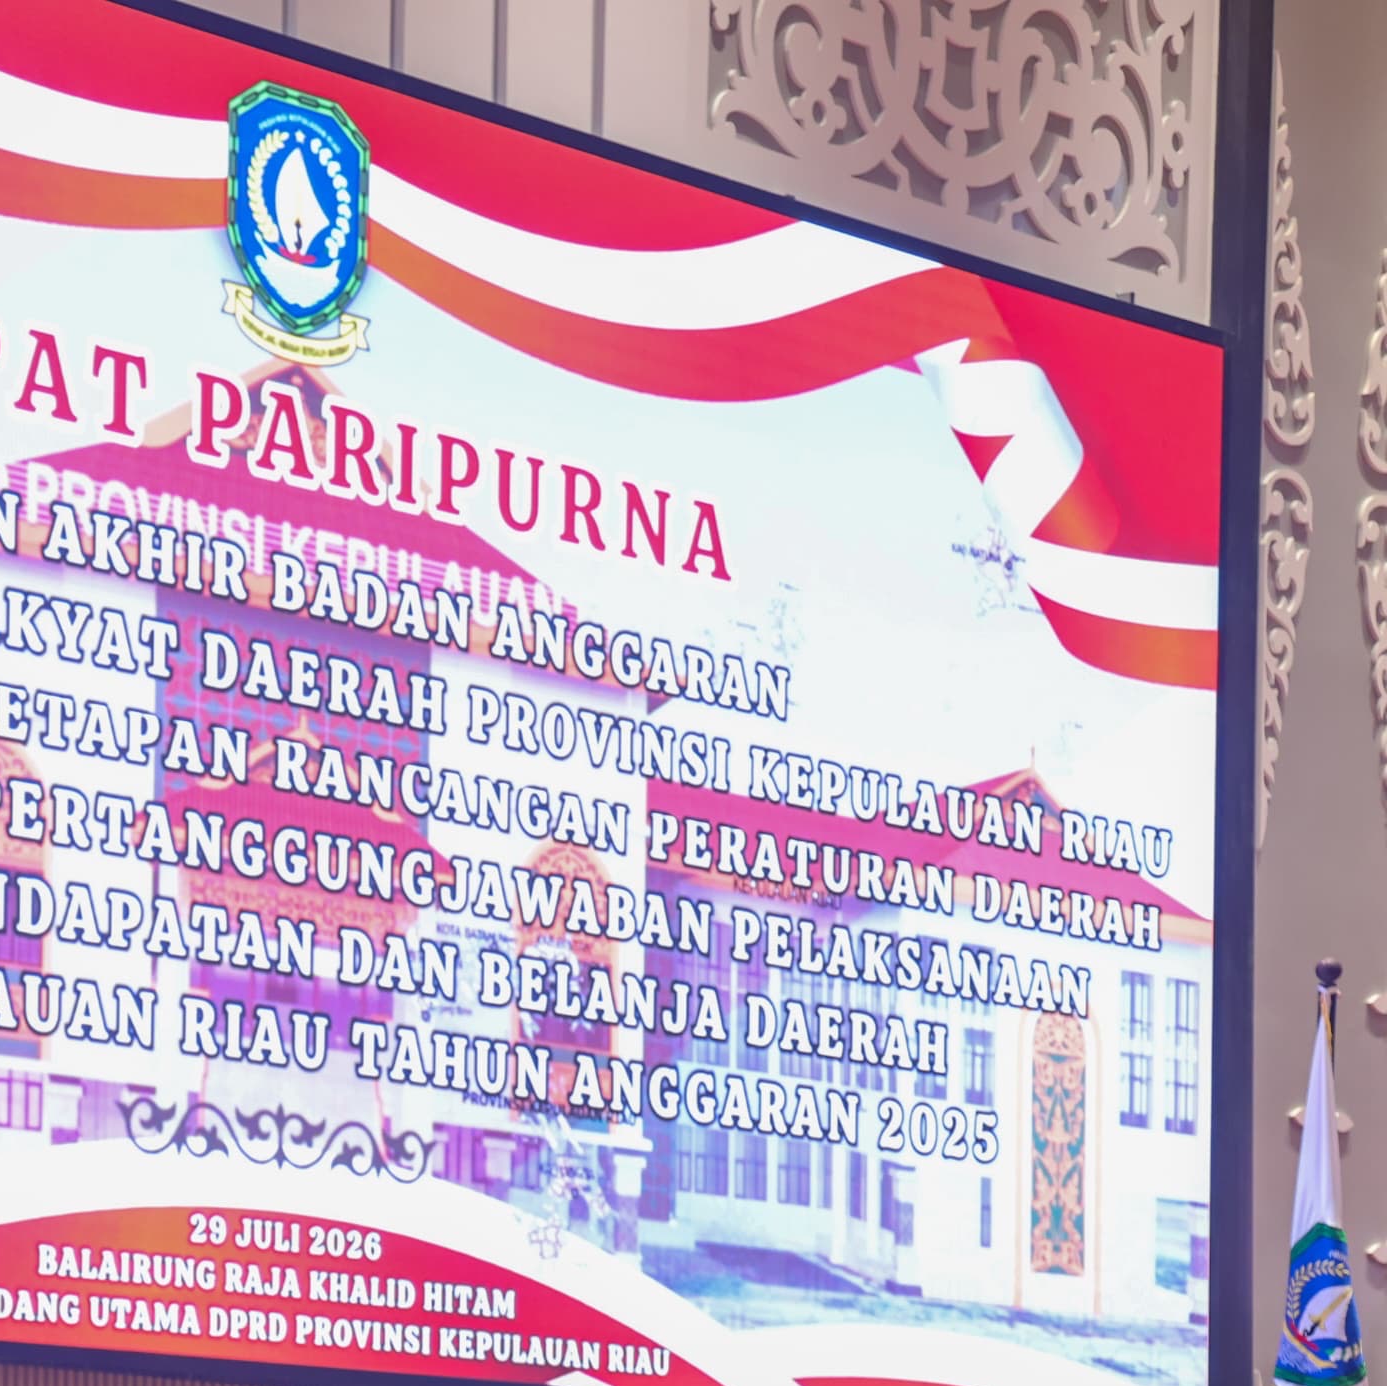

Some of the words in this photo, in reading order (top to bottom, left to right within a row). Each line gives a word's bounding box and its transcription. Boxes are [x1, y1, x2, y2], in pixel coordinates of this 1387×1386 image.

[195, 371, 732, 580] PARIPURNA
[44, 503, 247, 602] AKHIR
[271, 550, 470, 648] BADAN
[491, 595, 791, 723] ANGGARAN
[202, 630, 444, 736] DAERAH
[466, 686, 730, 797] PROVINSI
[747, 747, 1042, 855] KEPULAUAN
[1060, 812, 1174, 880] RIAU
[273, 735, 630, 857] RANCANGAN
[648, 812, 953, 916] PERATURAN
[971, 875, 1163, 953] DAERAH
[338, 928, 458, 998] DAN
[479, 947, 728, 1040] BELANJA
[746, 1000, 949, 1077] DAERAH
[732, 901, 1091, 1019] PELAKSANAAN
[180, 997, 329, 1070] RIAU
[350, 1020, 550, 1110] TAHUN
[571, 1056, 859, 1145] ANGGARAN
[878, 1098, 999, 1166] 2025
[37, 1243, 217, 1291] BALAIRUNG
[225, 1260, 301, 1300] RAJA
[310, 1270, 416, 1311] KHALID
[424, 1283, 516, 1320] HITAM
[189, 1213, 230, 1244] 29
[235, 1217, 303, 1252] JULI
[308, 1225, 382, 1261] 2026
[89, 1298, 201, 1336] UTAMA
[209, 1309, 288, 1344] DPRD
[295, 1315, 431, 1356] PROVINSI
[439, 1330, 600, 1370] KEPULAUAN
[608, 1344, 670, 1377] RIAU
